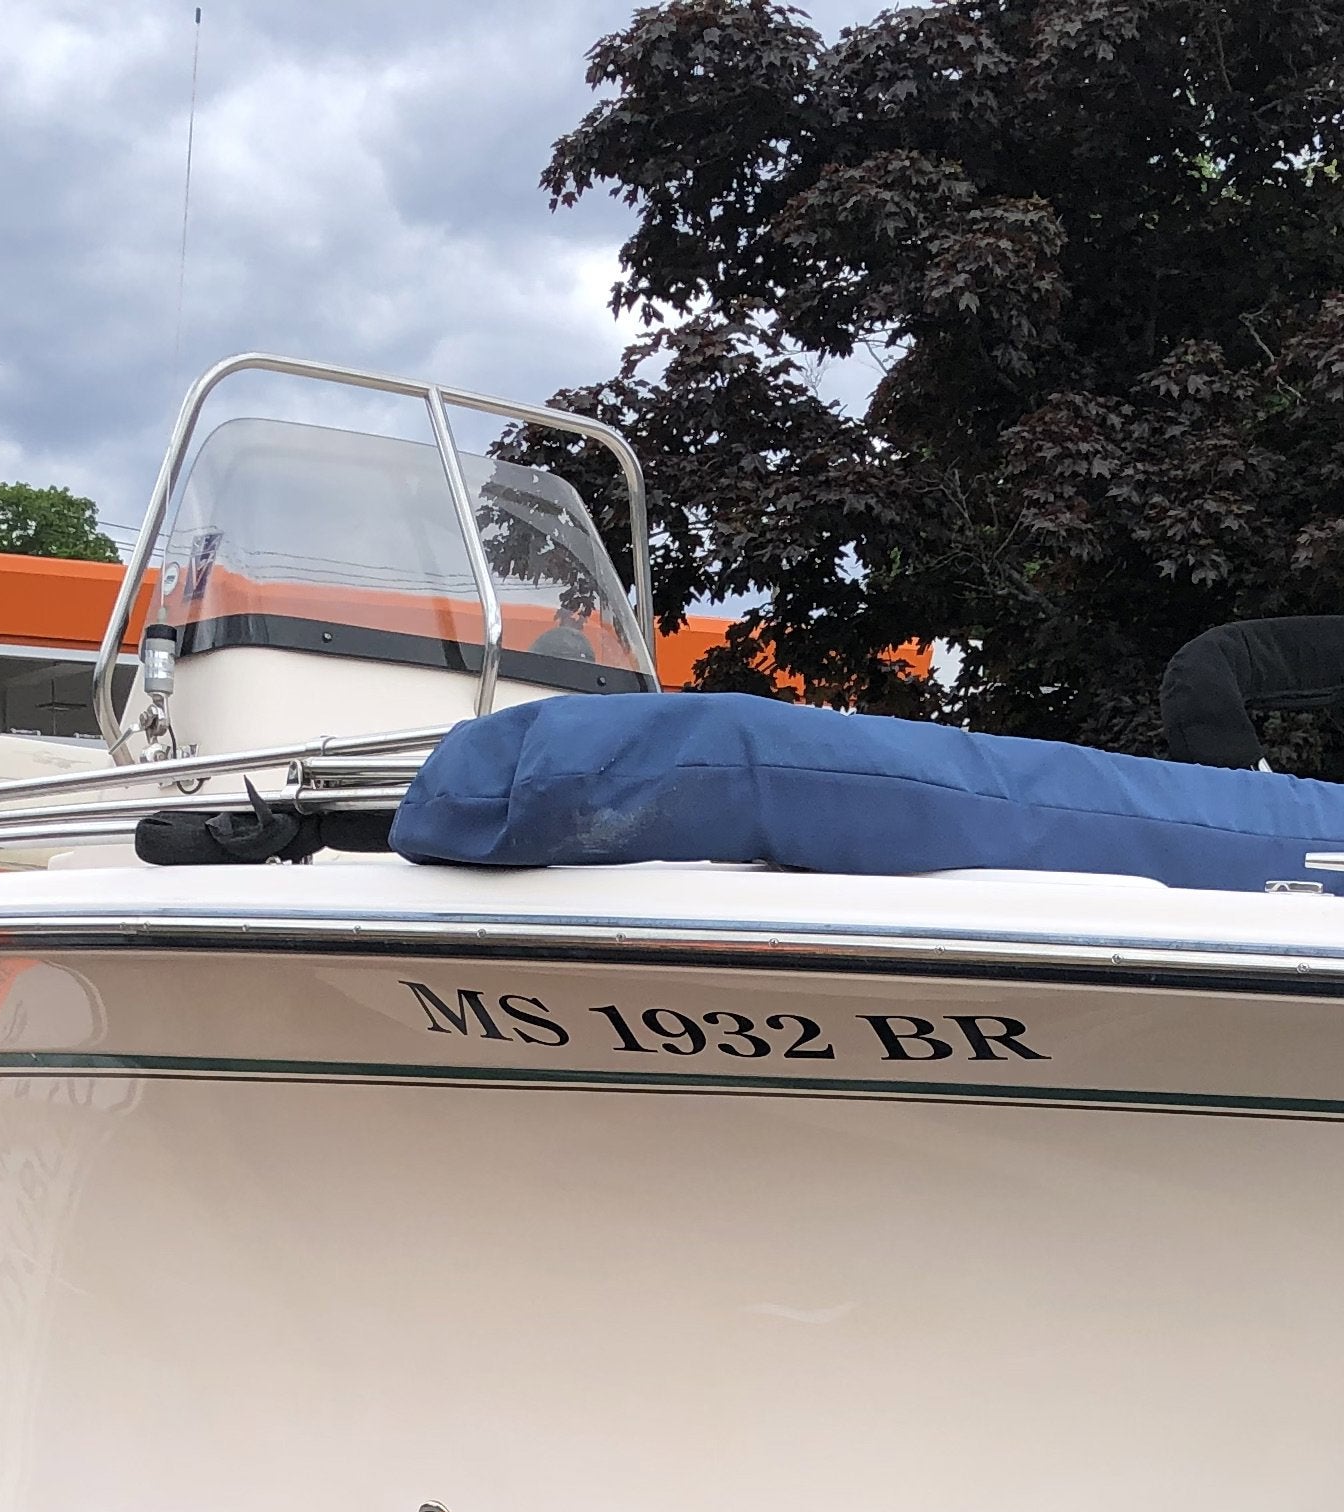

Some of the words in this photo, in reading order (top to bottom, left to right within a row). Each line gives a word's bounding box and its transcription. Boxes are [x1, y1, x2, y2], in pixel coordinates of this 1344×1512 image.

[399, 980, 570, 1047] MS
[589, 1005, 836, 1060] 1932
[856, 1014, 1052, 1061] BR
